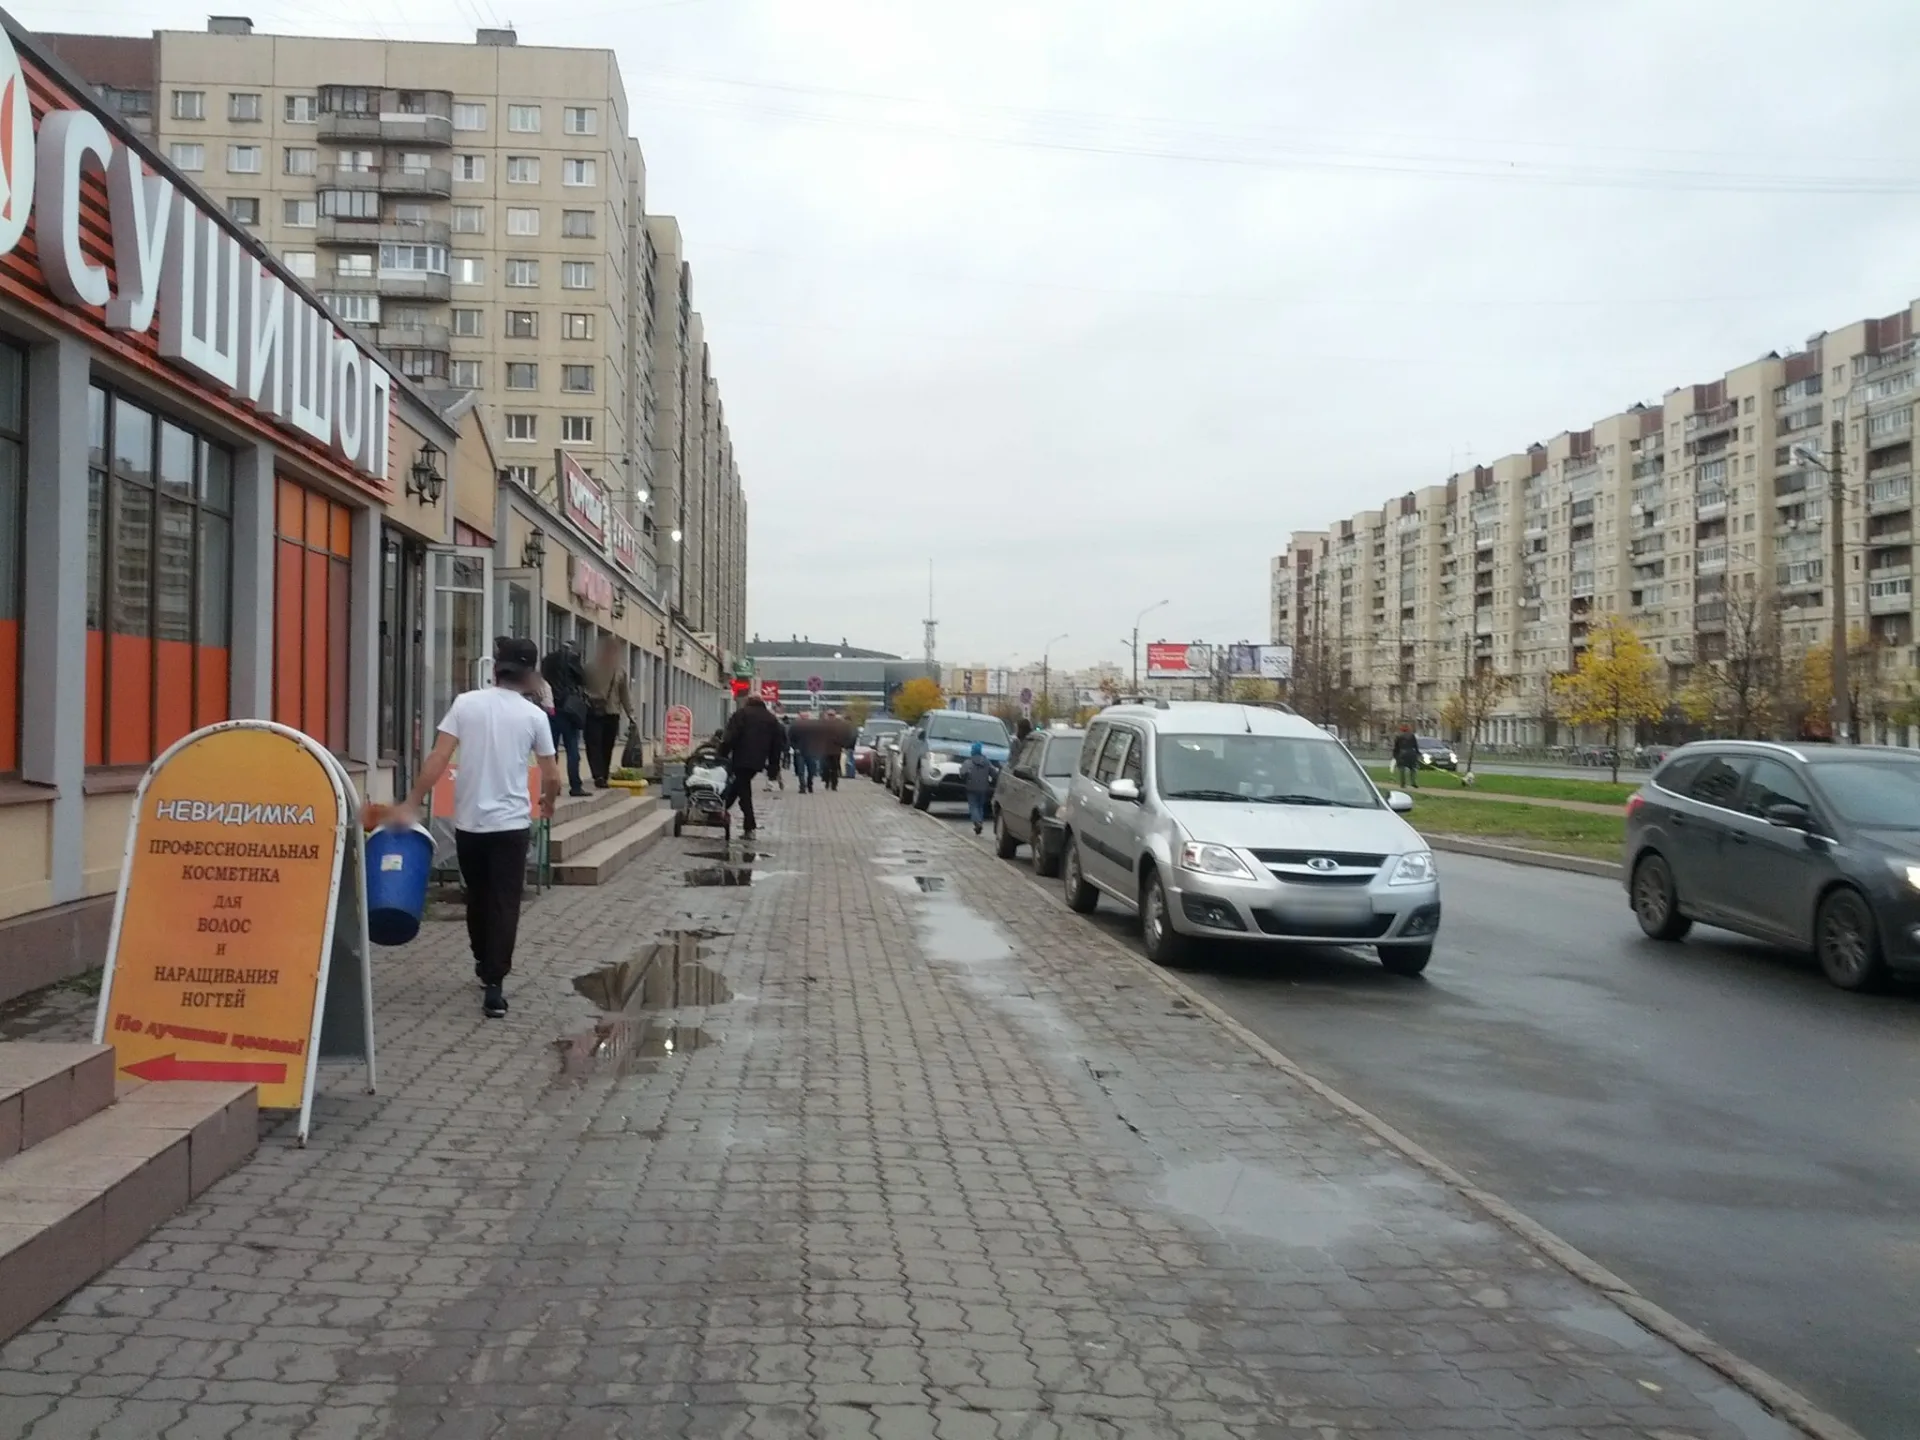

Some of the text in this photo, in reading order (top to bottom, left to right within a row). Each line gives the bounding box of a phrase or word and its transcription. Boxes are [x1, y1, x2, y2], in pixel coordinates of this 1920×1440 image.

[156, 799, 316, 826] НЕВИДИМКА
[149, 839, 319, 859] ПРОФЕССИОНАЛЬНАЯ
[181, 865, 280, 883] КОСМЕТИКА
[213, 896, 242, 910] ДЛЯ
[196, 918, 252, 934] ВОЛОС
[154, 966, 279, 985] НАРАЩИВАНИЯ
[180, 989, 246, 1009] НОГТЕЙ
